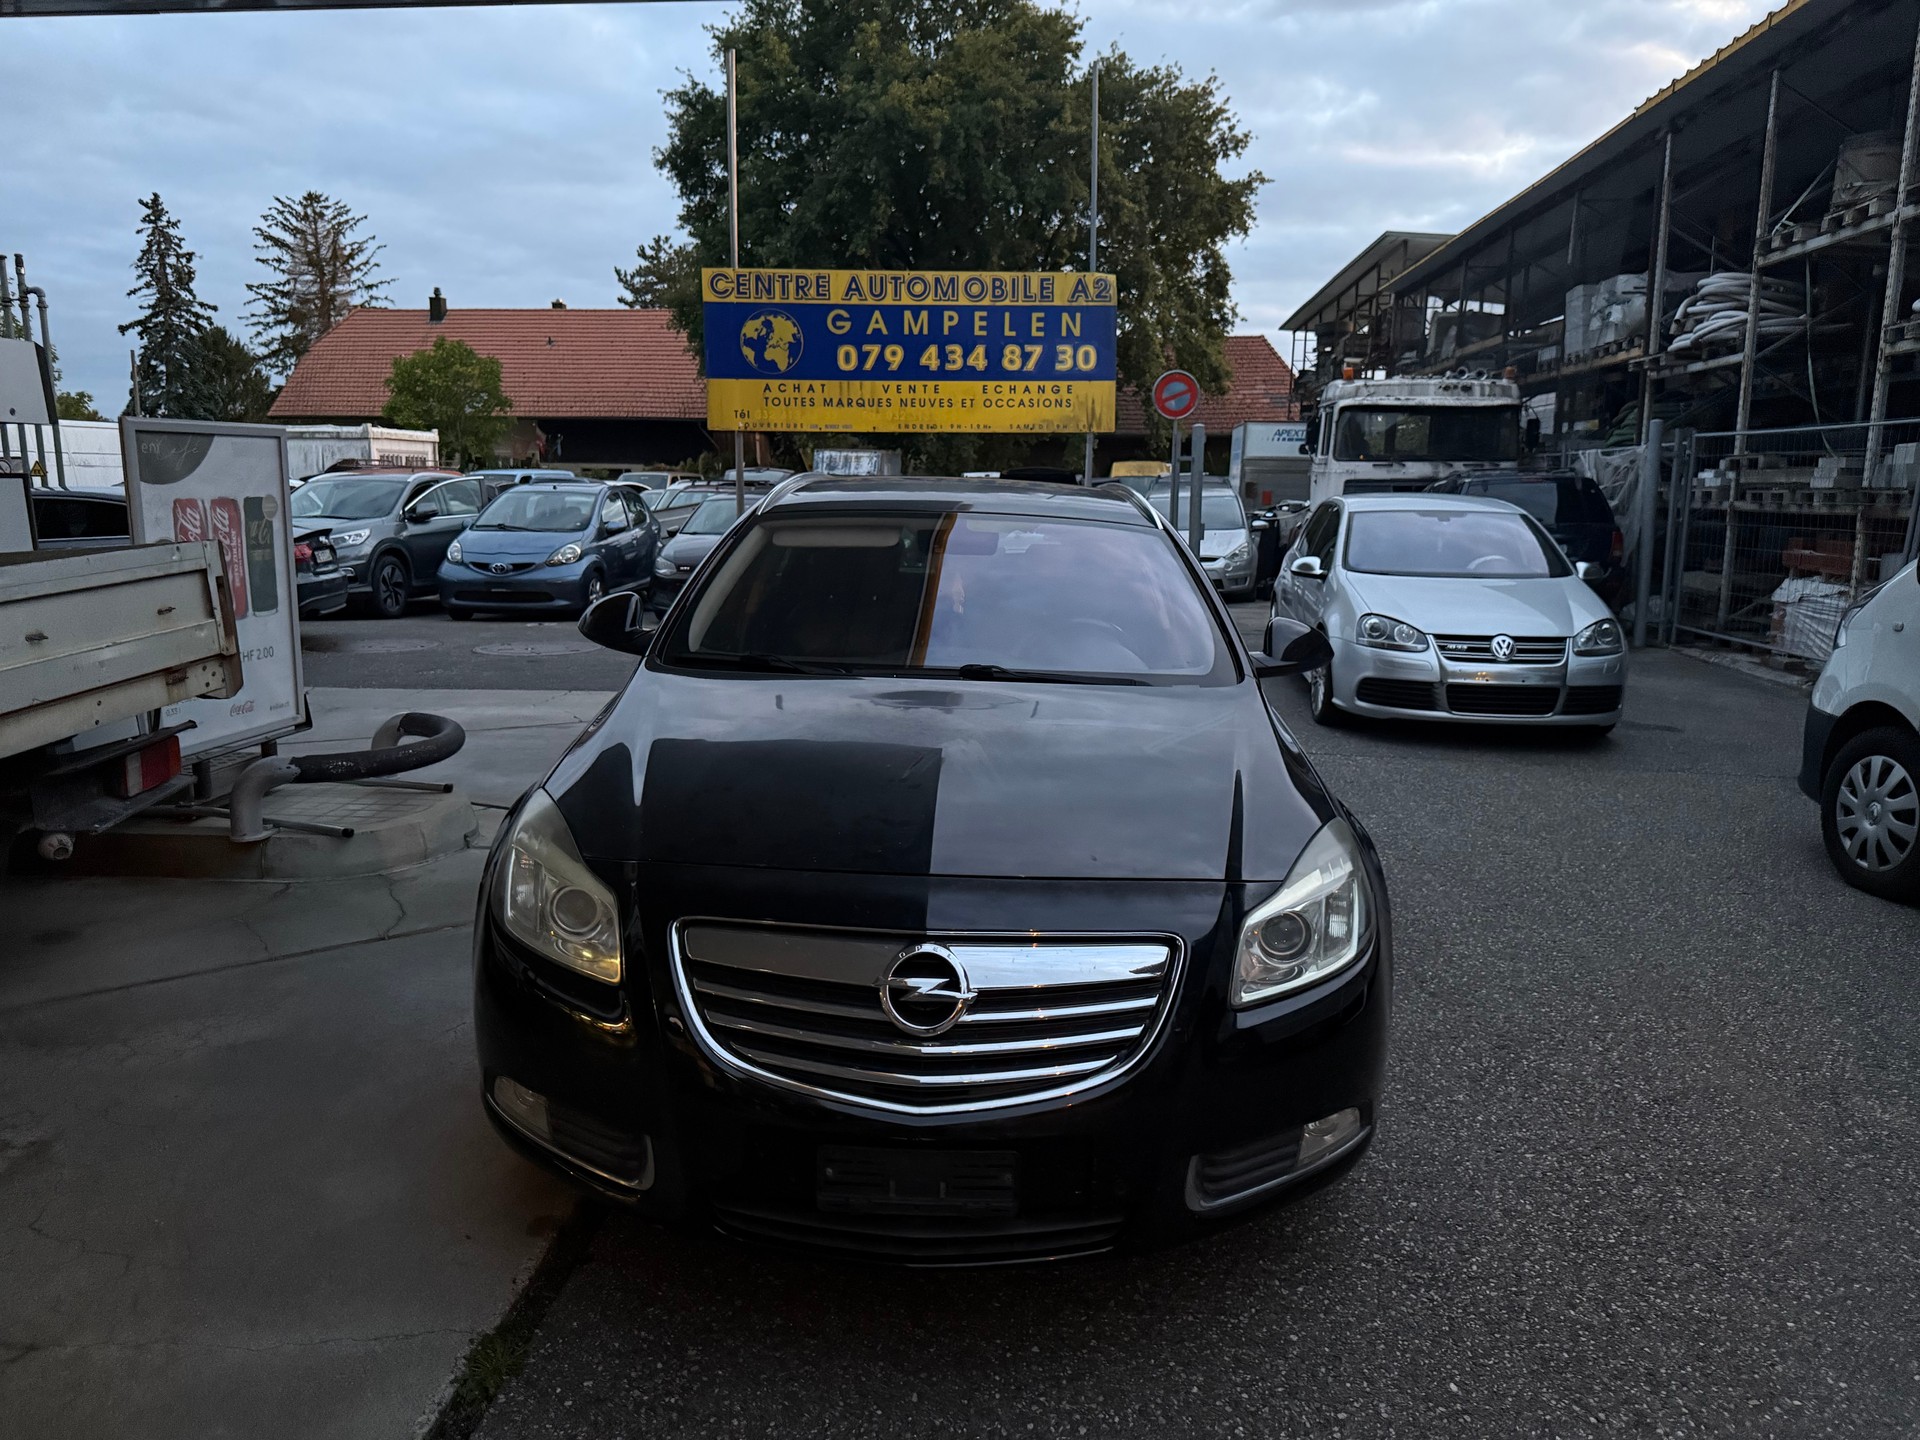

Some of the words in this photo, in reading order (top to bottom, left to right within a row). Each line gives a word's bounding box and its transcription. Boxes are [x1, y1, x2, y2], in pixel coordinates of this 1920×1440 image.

[708, 271, 831, 300] CENTRE
[841, 274, 1055, 303] AUTOMOBILE
[1067, 277, 1111, 303] A2
[826, 309, 1082, 337] GAMPELEN
[837, 344, 905, 371] 079
[919, 344, 988, 371] 434
[1001, 344, 1044, 371] 87
[1055, 345, 1098, 372] 30
[763, 383, 826, 394] ACHAT
[882, 384, 941, 395] VENTE
[982, 385, 1073, 395] ECHANGE
[764, 396, 816, 408] TOUTES
[823, 397, 892, 408] MARQUES
[900, 398, 953, 409] NEUVES
[961, 398, 975, 409] ET
[983, 398, 1073, 409] OCCASIONS
[734, 410, 751, 419] Tél
[240, 650, 255, 663] HF
[898, 944, 953, 960] OPEL
